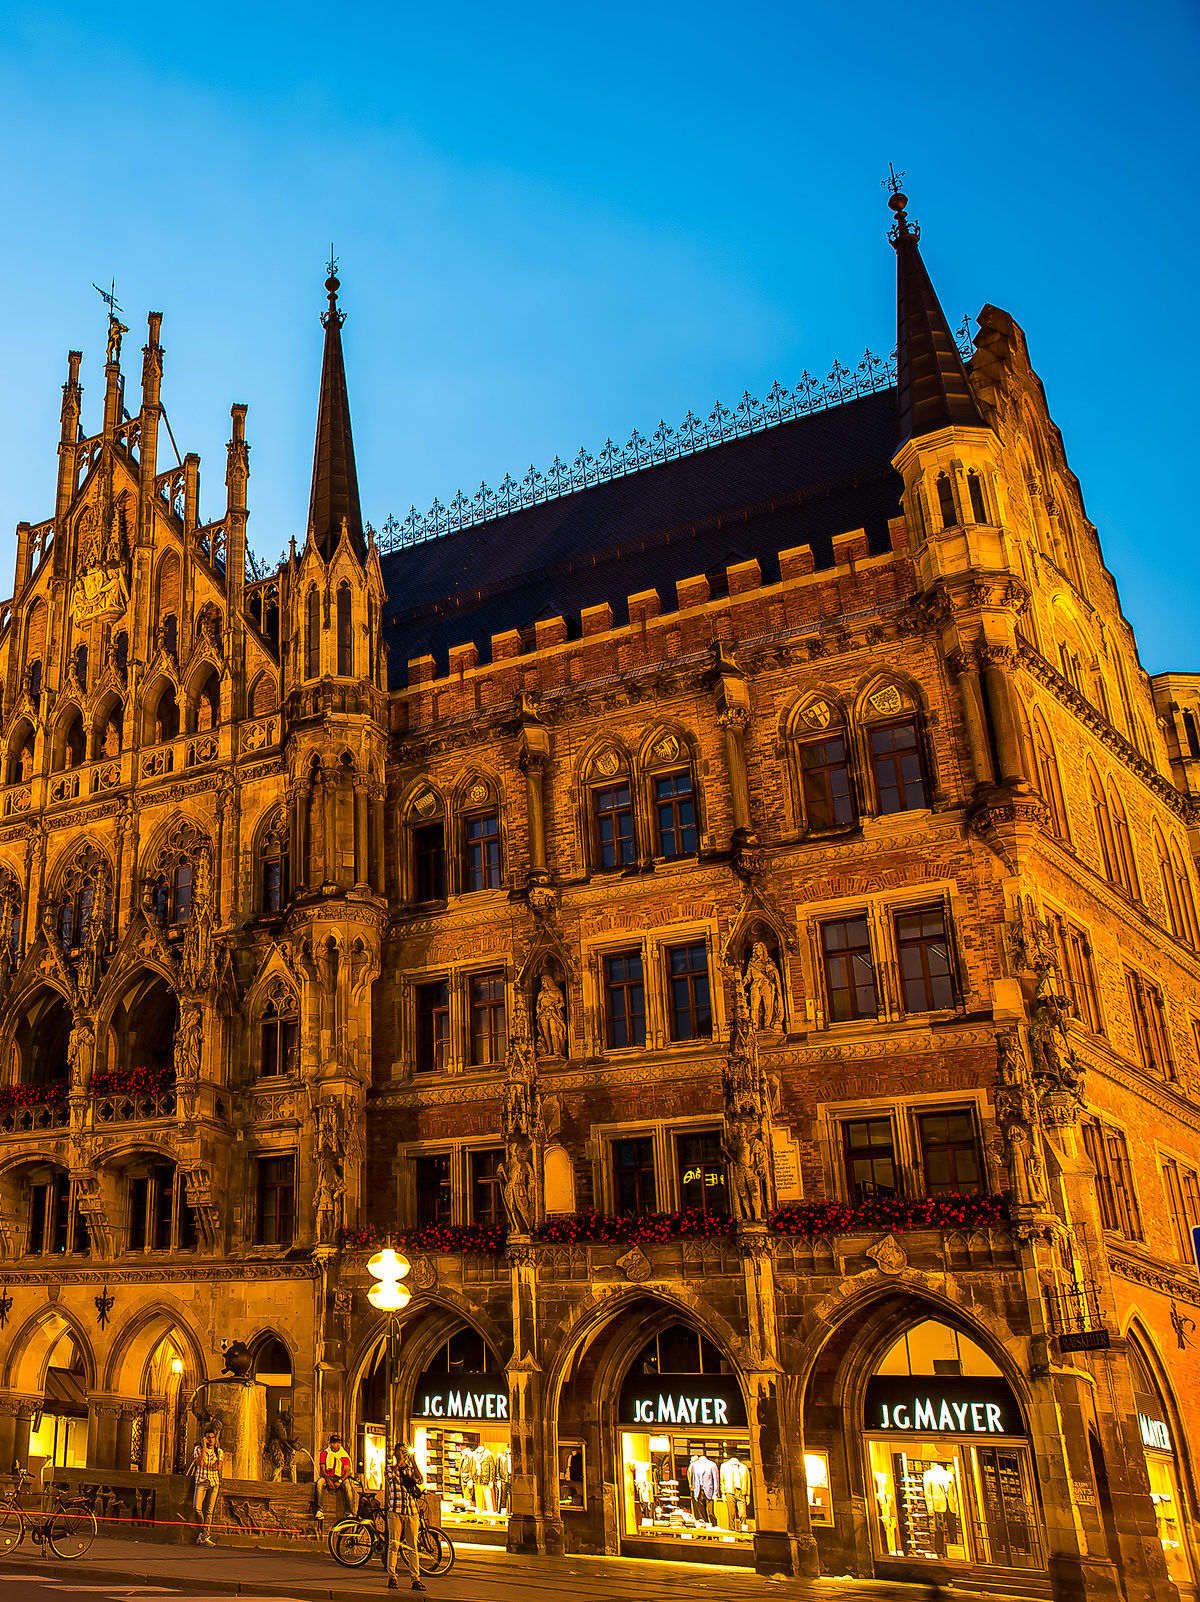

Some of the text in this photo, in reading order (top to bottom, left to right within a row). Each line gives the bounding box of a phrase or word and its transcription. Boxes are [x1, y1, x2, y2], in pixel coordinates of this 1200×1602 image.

[447, 1390, 508, 1418] MAYER
[658, 1393, 729, 1424] MAYER
[915, 1397, 1005, 1432] MAYER
